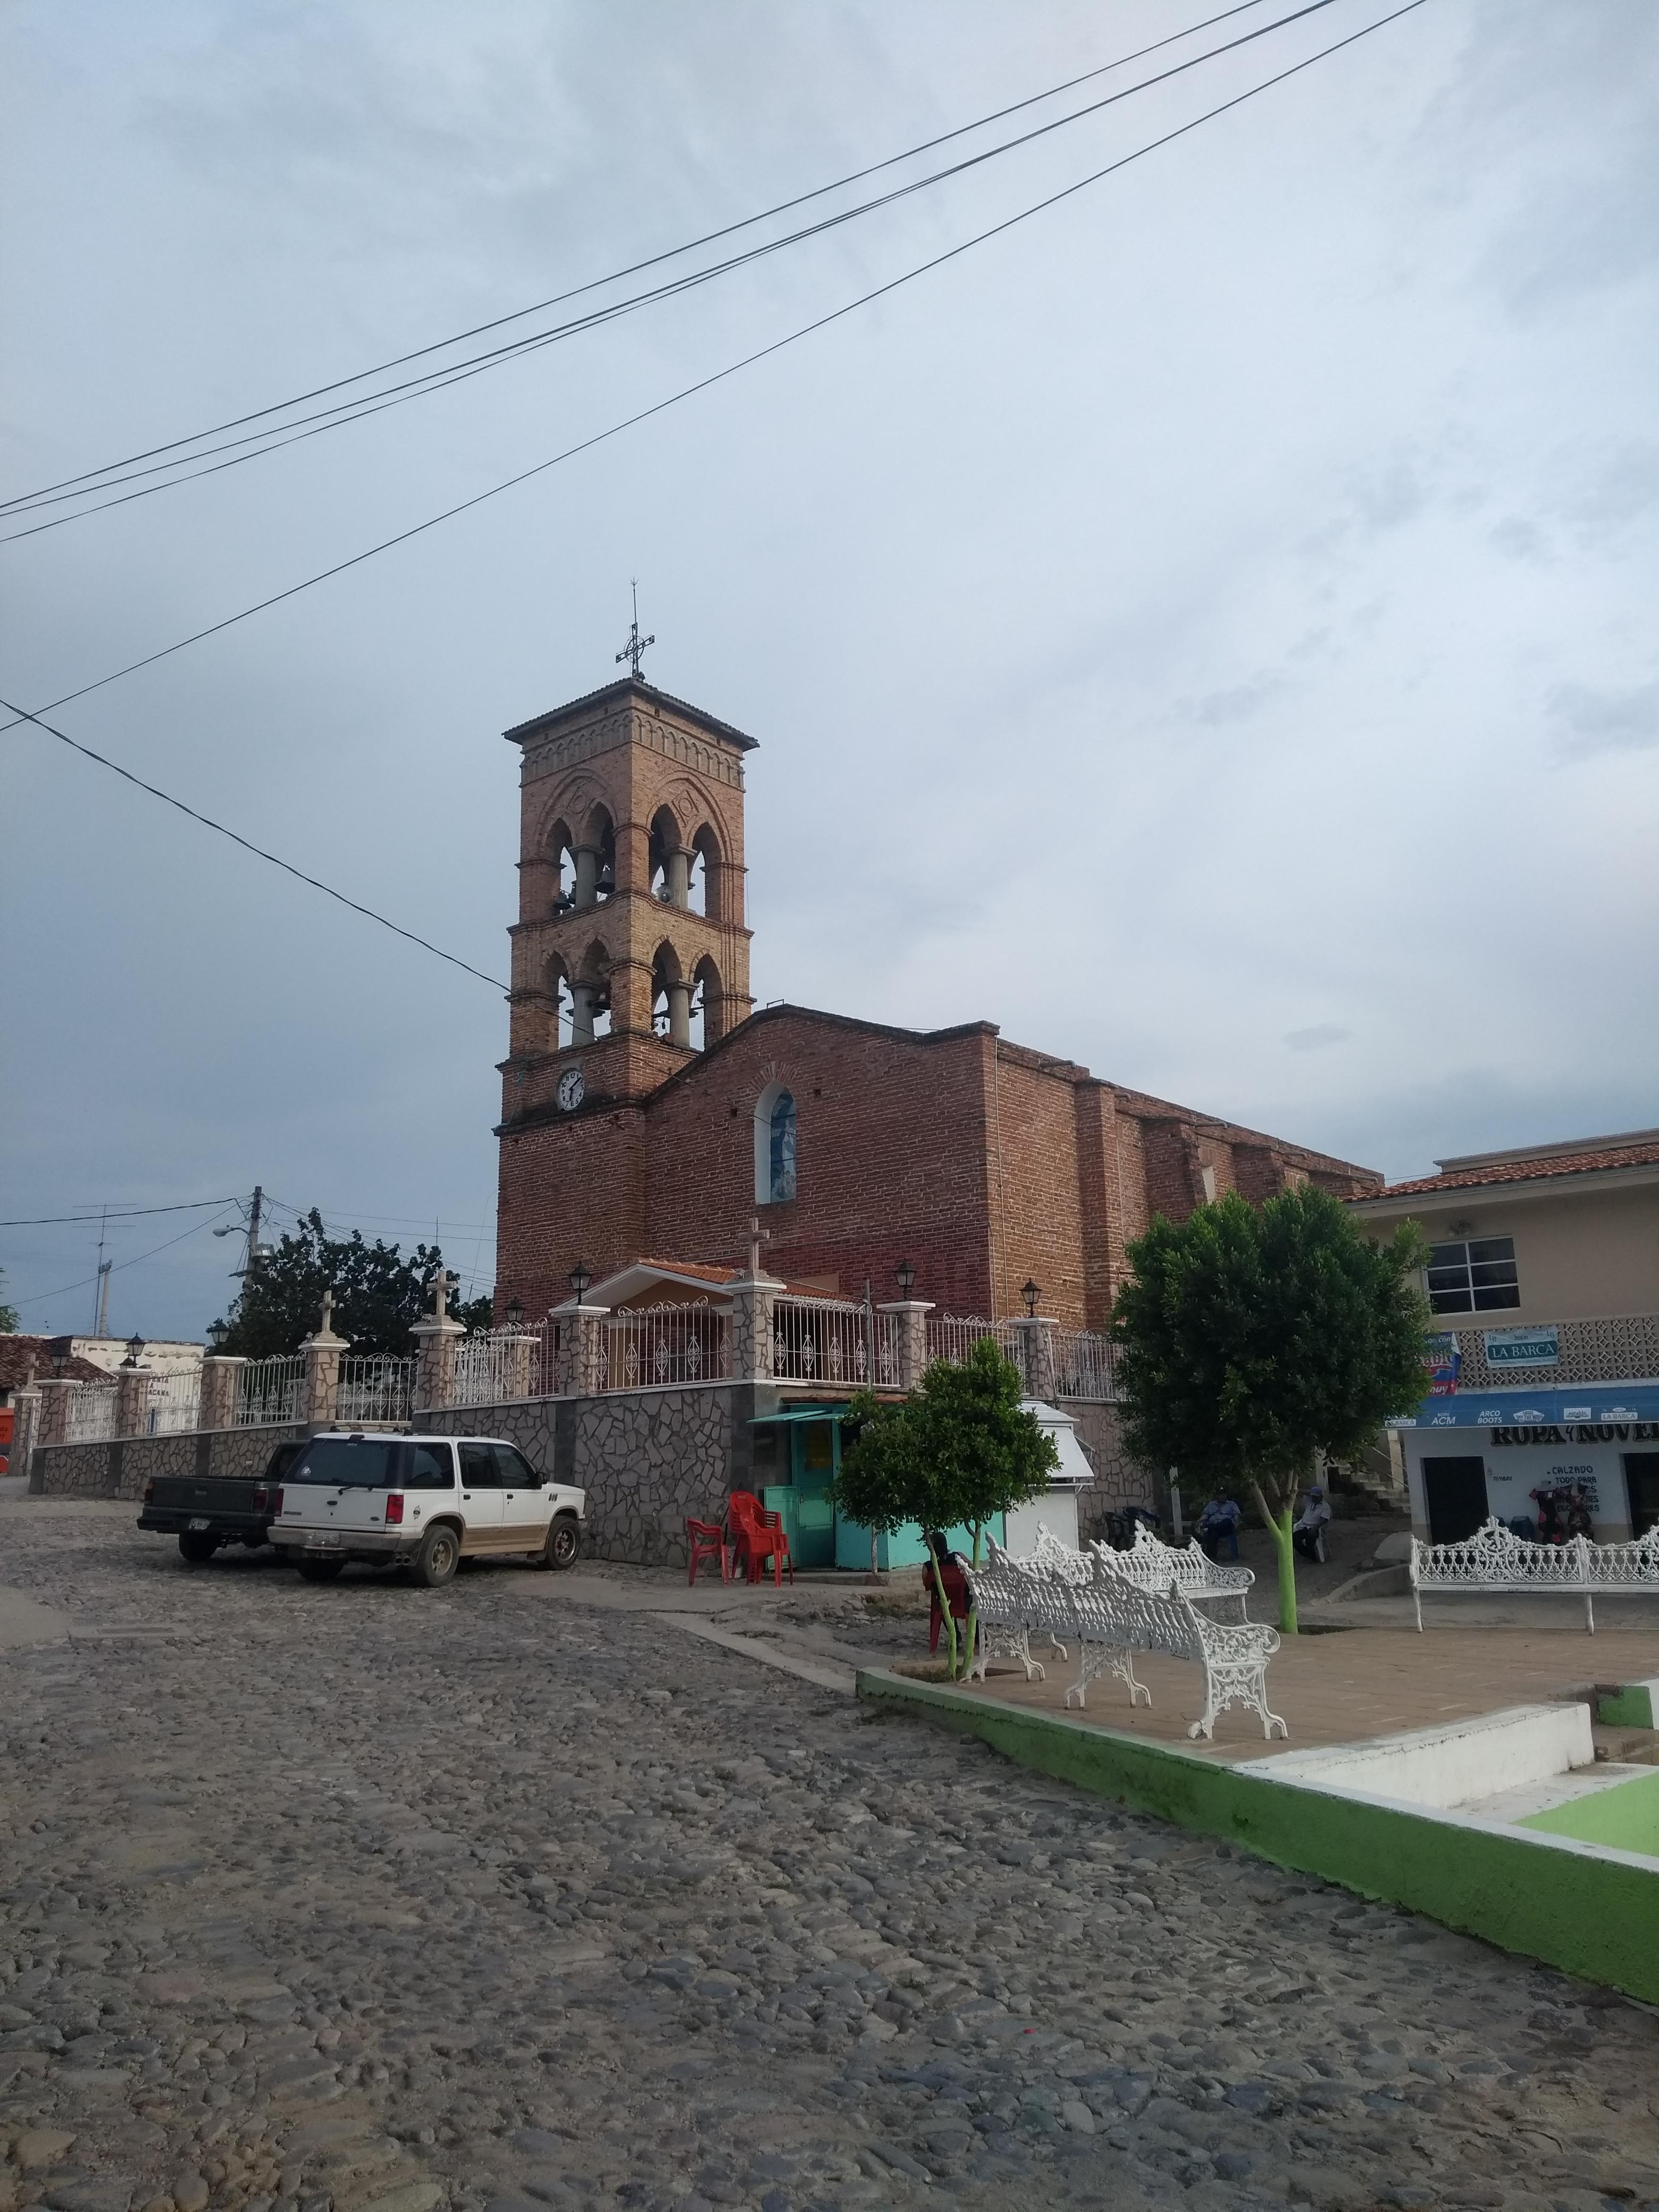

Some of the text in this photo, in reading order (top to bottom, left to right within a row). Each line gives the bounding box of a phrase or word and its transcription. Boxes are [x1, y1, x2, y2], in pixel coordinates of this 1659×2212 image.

[1492, 1343, 1556, 1358] LA BARCA
[1431, 1417, 1456, 1425] ACM
[1490, 1425, 1567, 1446] ROPA
[1552, 1465, 1593, 1474] CALZADO
